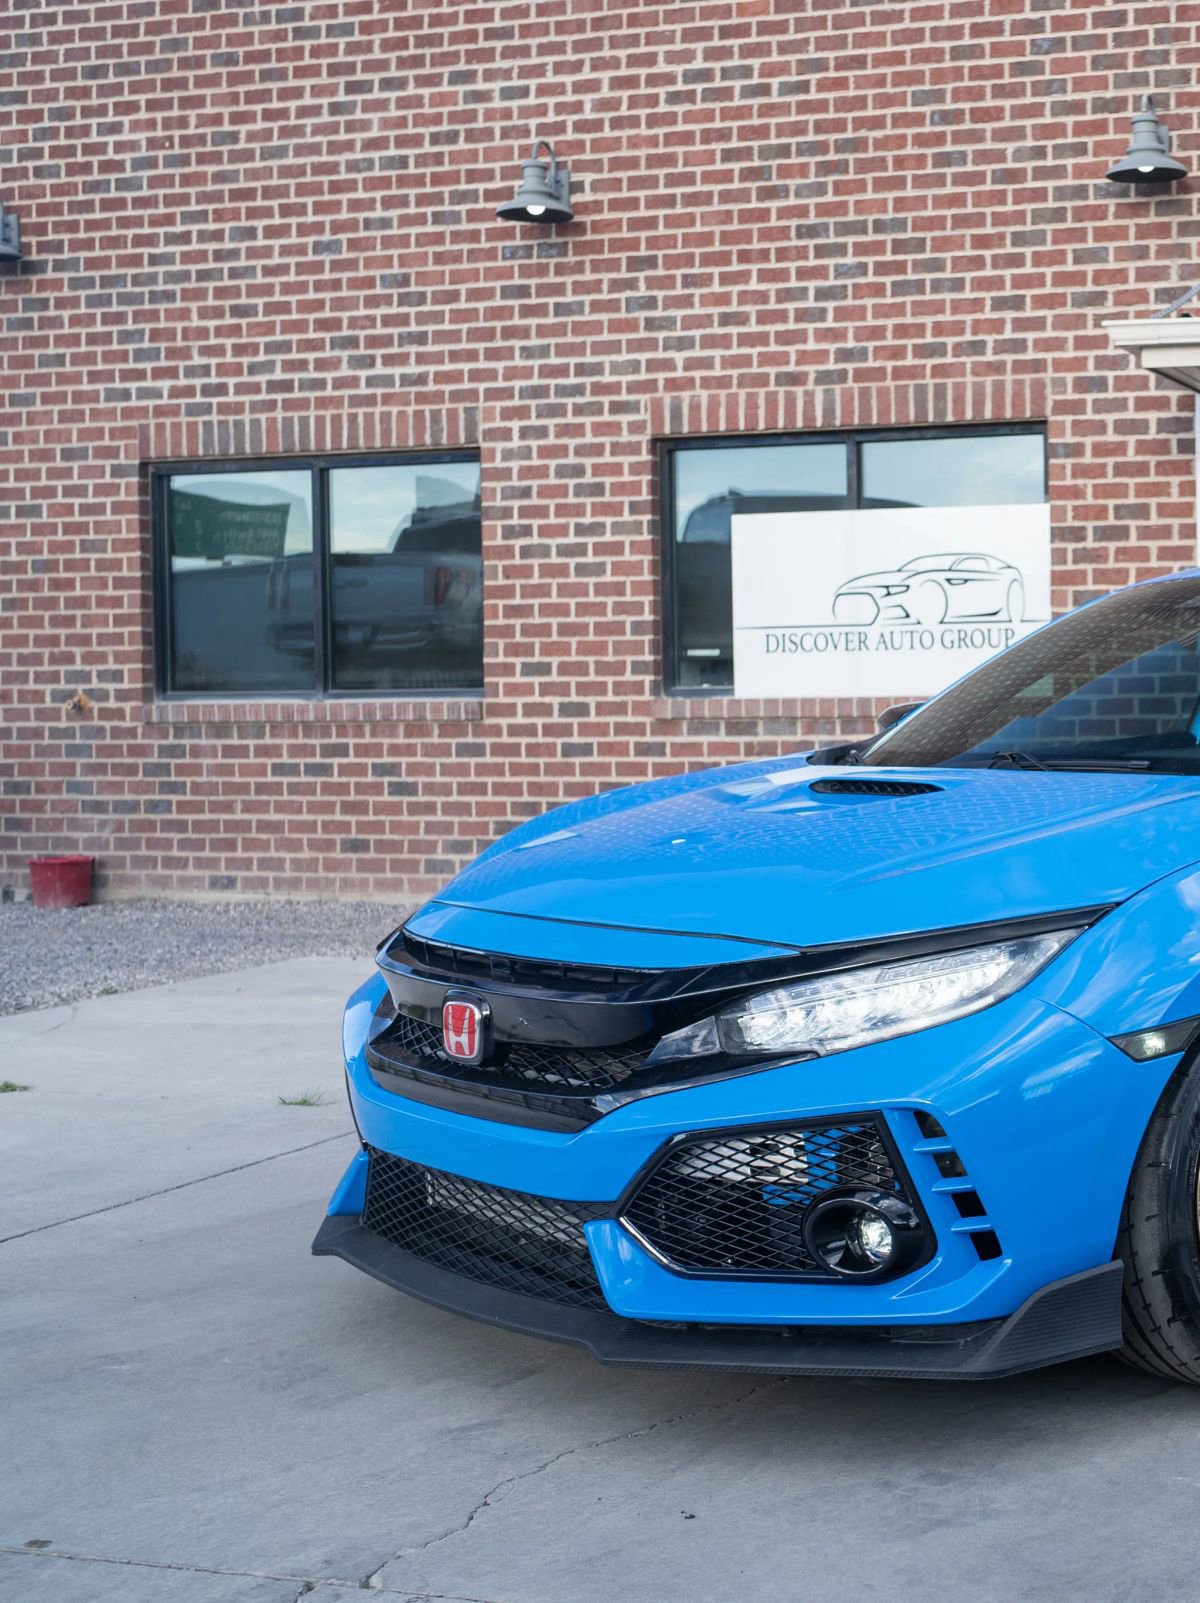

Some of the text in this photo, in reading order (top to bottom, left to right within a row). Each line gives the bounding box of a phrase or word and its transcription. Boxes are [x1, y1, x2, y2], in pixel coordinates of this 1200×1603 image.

[765, 627, 1015, 653] DISCOVER AUTO GROUP
